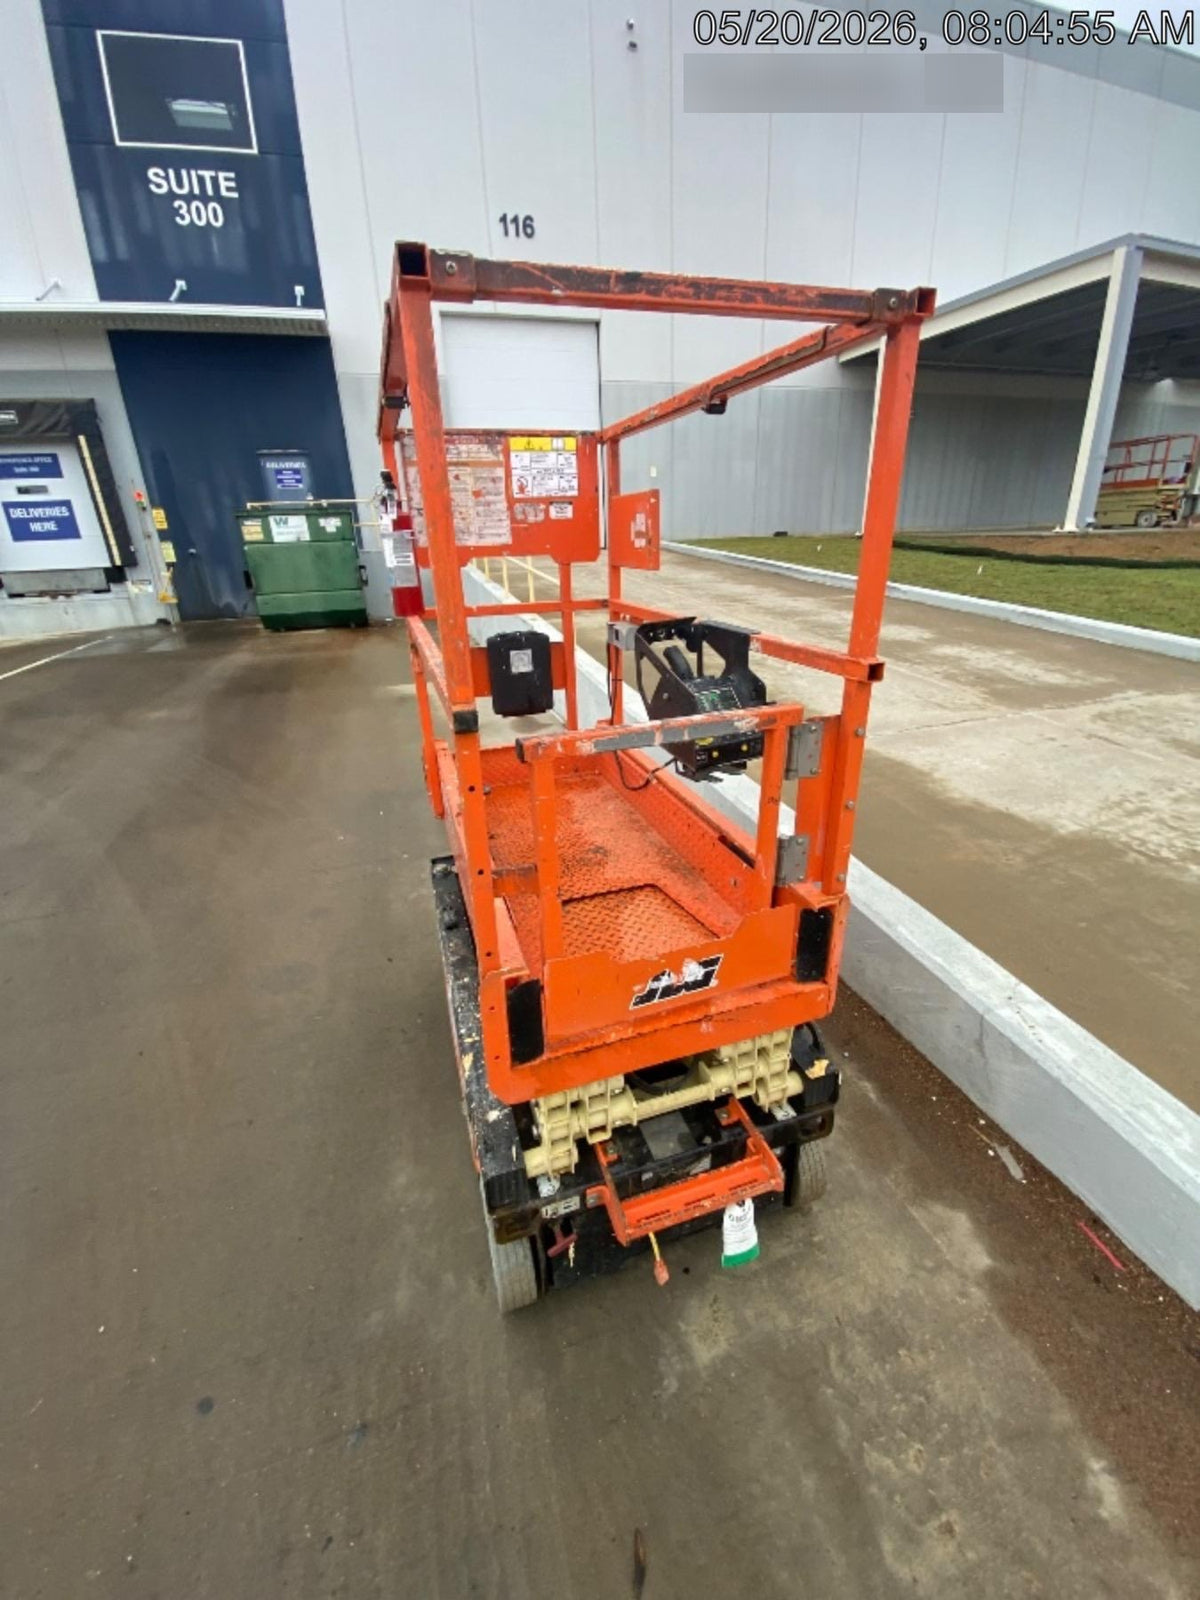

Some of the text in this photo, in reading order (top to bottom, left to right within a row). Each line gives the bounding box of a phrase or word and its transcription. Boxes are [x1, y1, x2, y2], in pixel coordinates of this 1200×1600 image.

[147, 167, 239, 198] SUITE
[173, 200, 224, 228] 300
[499, 213, 535, 239] 116
[8, 506, 70, 518] DELIVERIES
[29, 521, 59, 532] HERE
